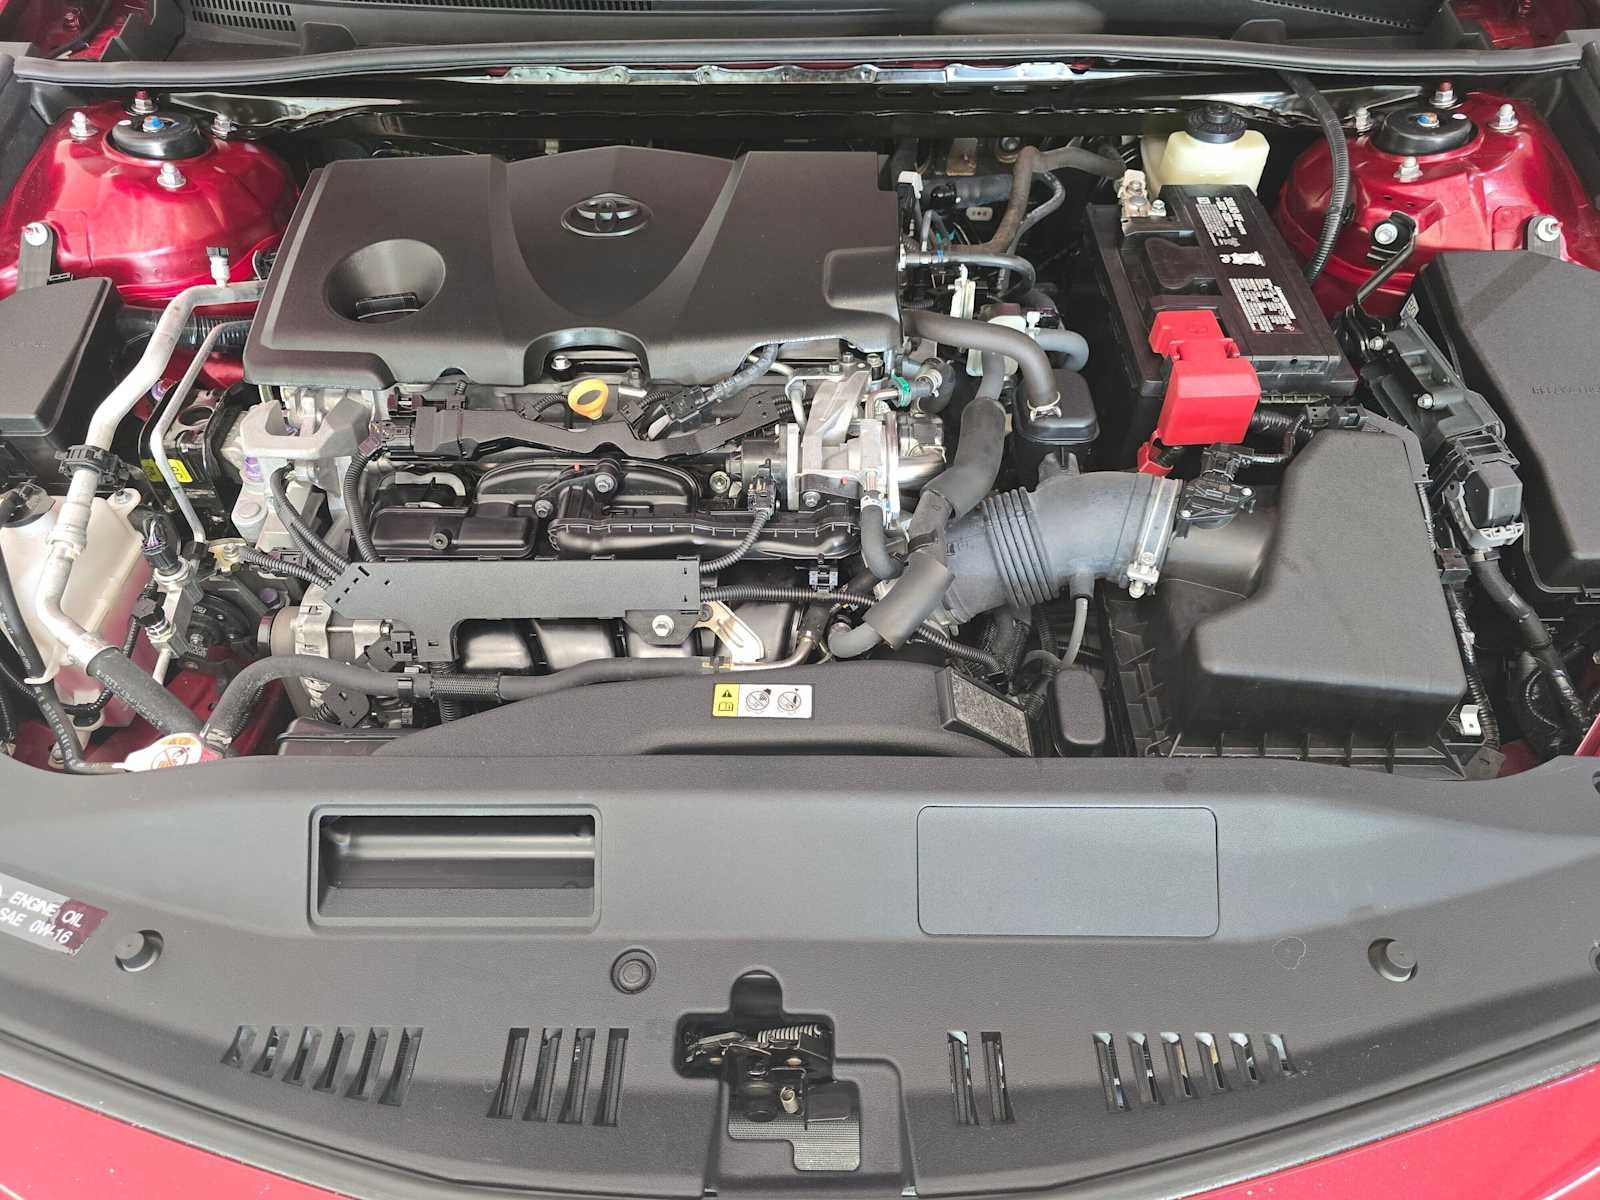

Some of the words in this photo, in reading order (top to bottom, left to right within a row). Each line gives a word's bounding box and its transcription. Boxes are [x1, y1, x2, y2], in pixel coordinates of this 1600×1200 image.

[0, 907, 27, 926] SAE
[9, 891, 60, 917] ENGINE
[61, 910, 84, 928] OIL
